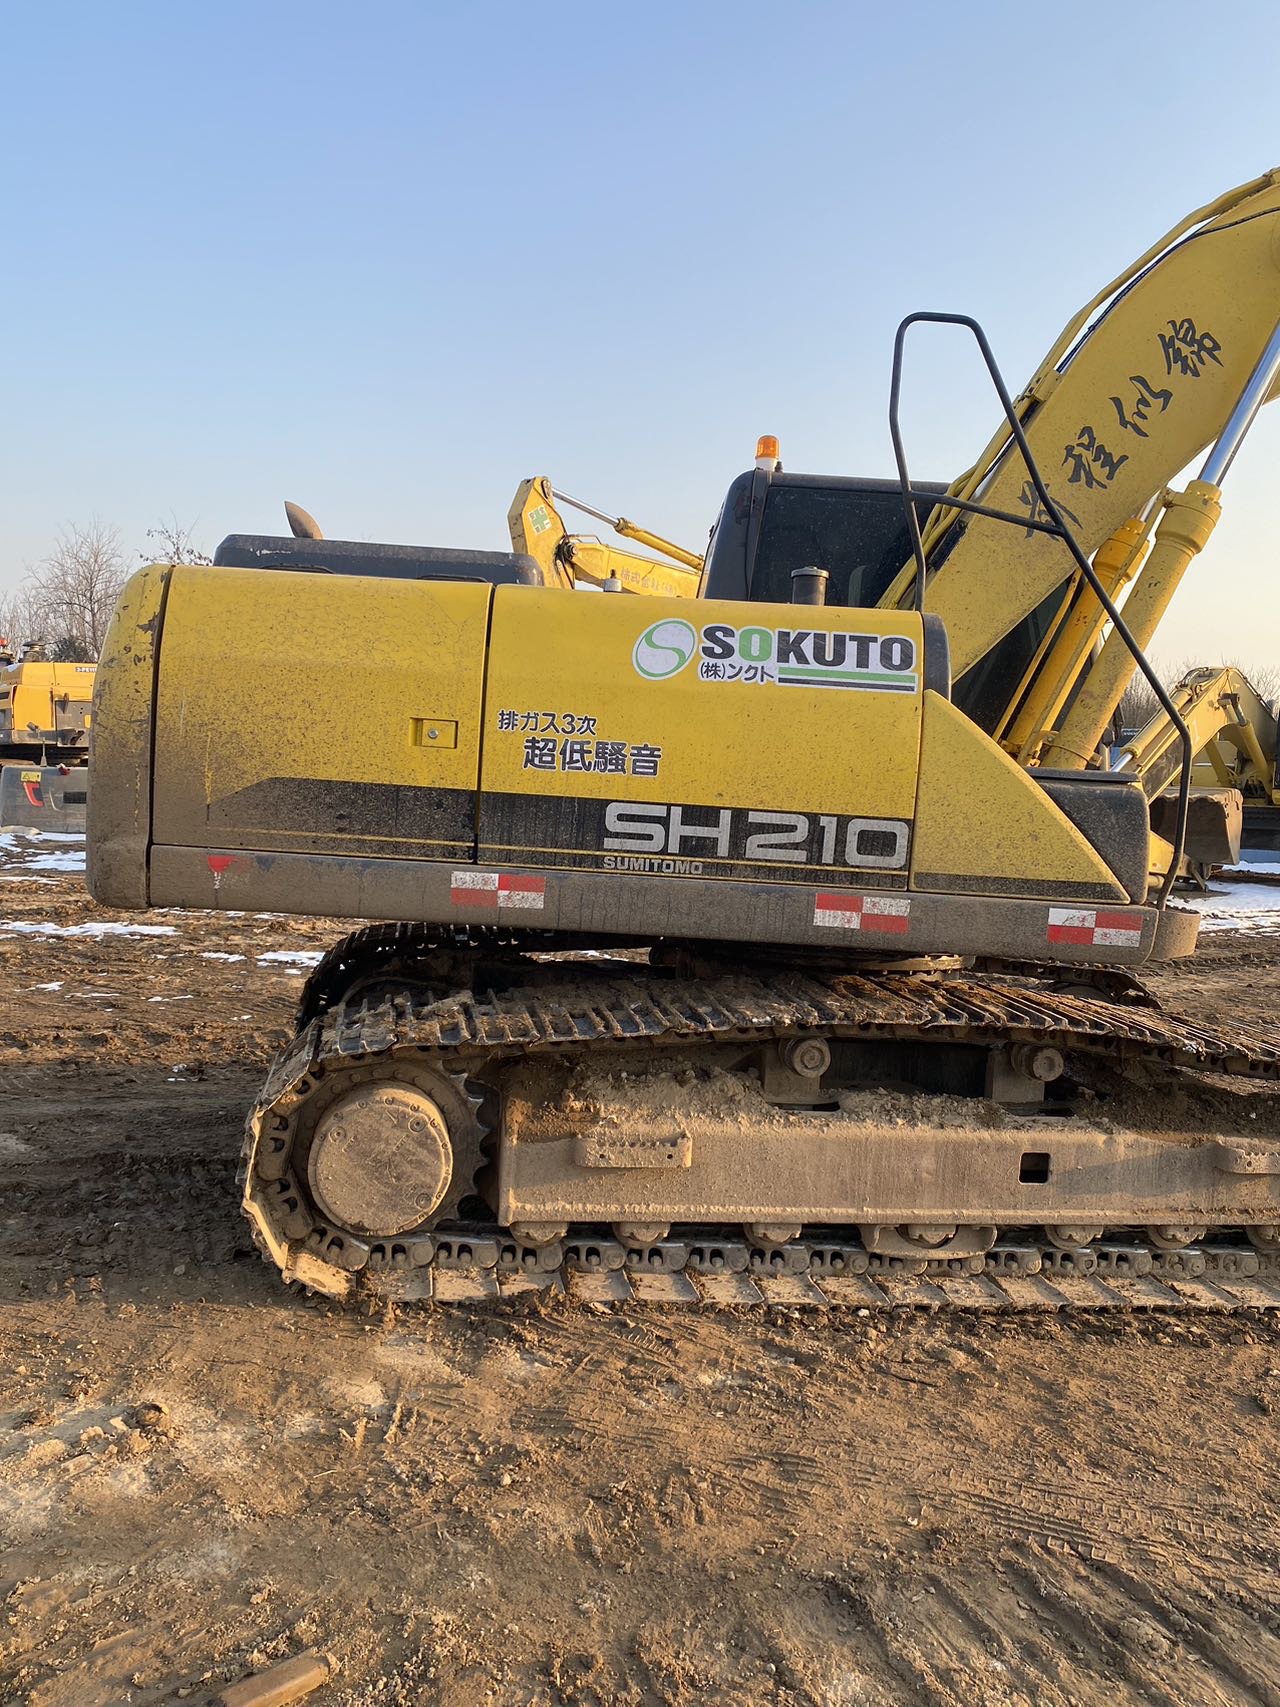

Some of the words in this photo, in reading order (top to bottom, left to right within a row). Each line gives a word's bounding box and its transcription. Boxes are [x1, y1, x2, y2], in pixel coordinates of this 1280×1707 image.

[701, 625, 914, 671] SOKUTO
[498, 710, 597, 736] 排ガス3次
[523, 737, 662, 776] 超低騒音
[603, 856, 703, 875] SUMITOMO
